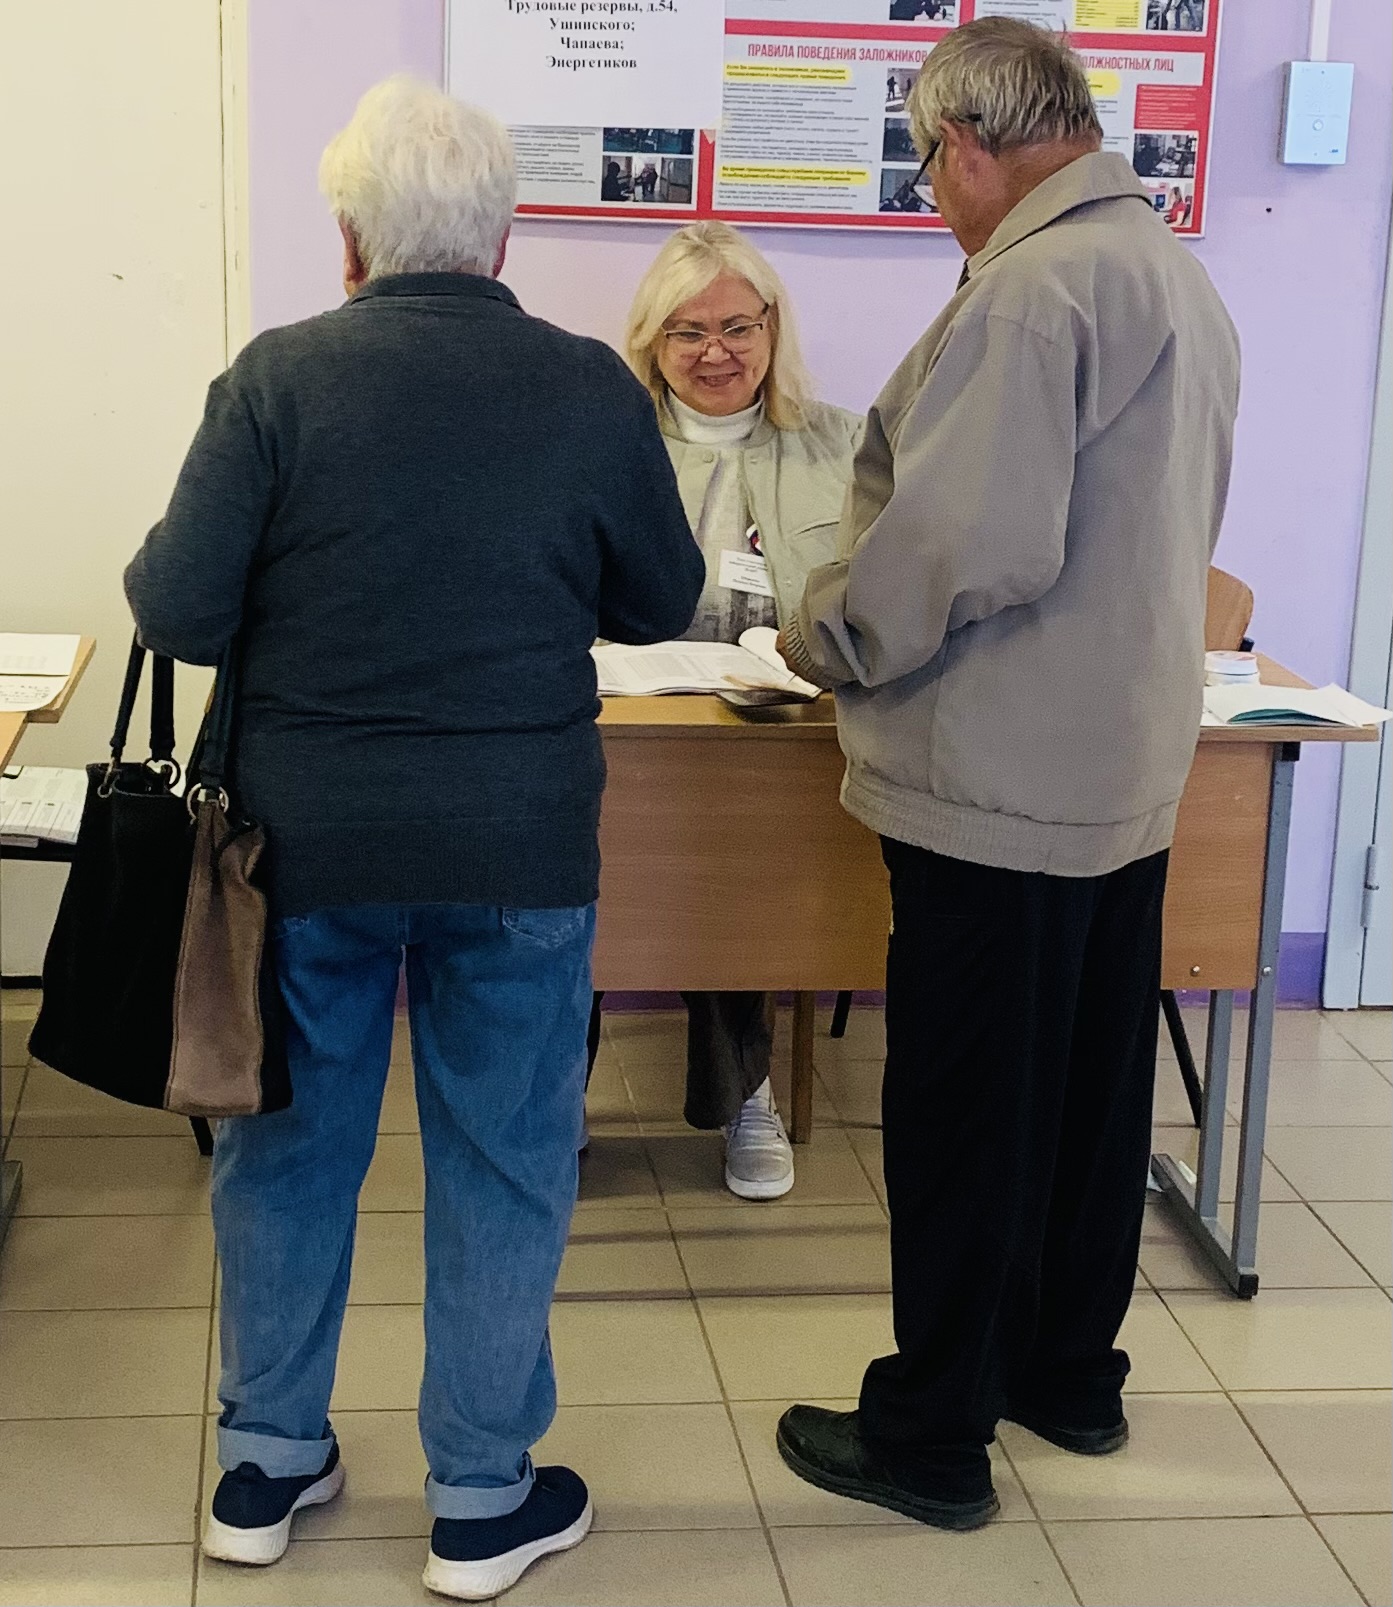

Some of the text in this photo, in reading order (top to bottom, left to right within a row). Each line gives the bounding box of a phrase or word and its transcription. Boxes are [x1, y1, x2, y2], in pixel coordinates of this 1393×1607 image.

[505, 0, 678, 15] Трудовые резервы, д.54,
[549, 17, 635, 32] Ушинского;
[560, 36, 625, 50] Чапаева;
[747, 43, 928, 63] ПРАВИЛА ПОВЕДЕНИЯ ЗАЛОЖНИКОВ
[545, 55, 638, 71] Энергетиков
[1081, 55, 1174, 73] ОЛЖНОСТНЫХ ЛИЦ
